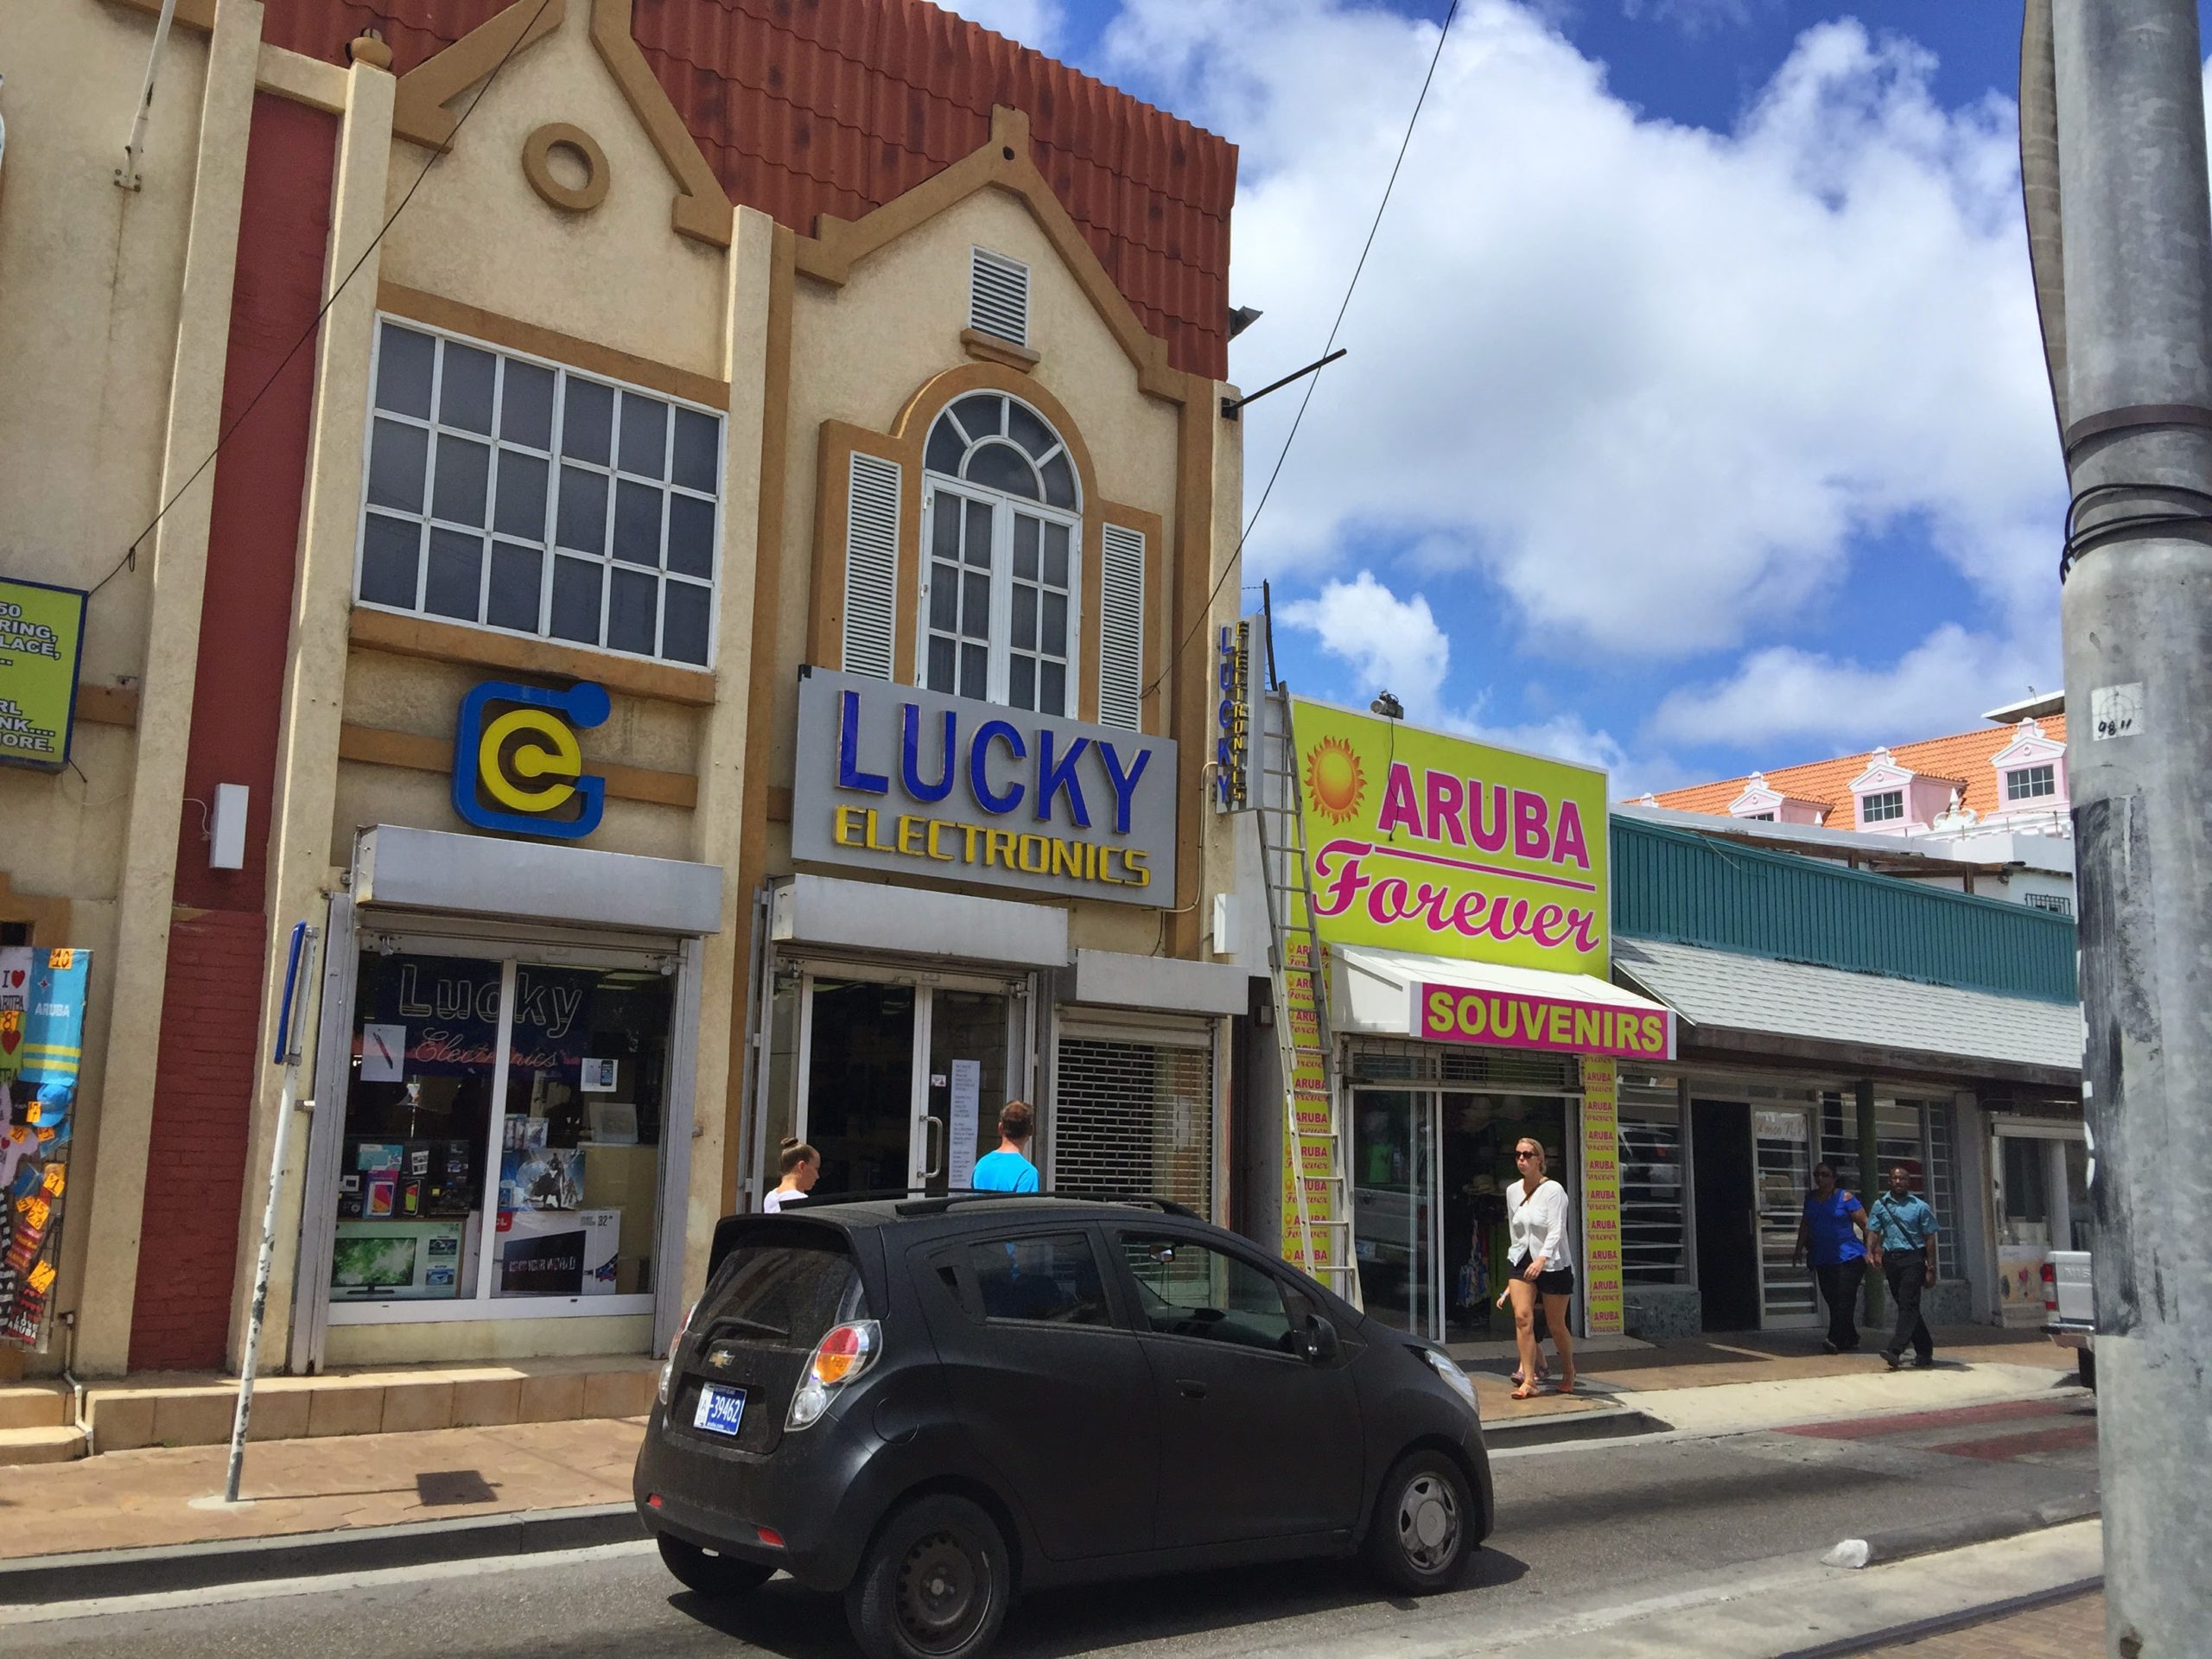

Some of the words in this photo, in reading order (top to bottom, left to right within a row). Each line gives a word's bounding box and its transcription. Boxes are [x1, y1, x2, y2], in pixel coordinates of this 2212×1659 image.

[1217, 626, 1233, 804] LUCKY
[836, 690, 1152, 835] LUCKY
[1377, 763, 1591, 870] ARUBA
[835, 804, 1152, 887] ELECTRONICS
[1313, 839, 1600, 953] Forever
[35, 1002, 71, 1018] ARUBA
[1427, 991, 1664, 1053] SOUVENIRS
[1587, 1072, 1611, 1082] ARUBA
[1587, 1102, 1612, 1111] ARUBA
[1588, 1131, 1613, 1141] ARUBA
[1589, 1160, 1614, 1170] ARUBA
[1590, 1190, 1615, 1199] ARUBA
[1591, 1220, 1617, 1230] ARUBA
[1592, 1250, 1618, 1259] ARUBA
[1592, 1281, 1618, 1290] ARUBA
[1594, 1311, 1619, 1320] ARUBA
